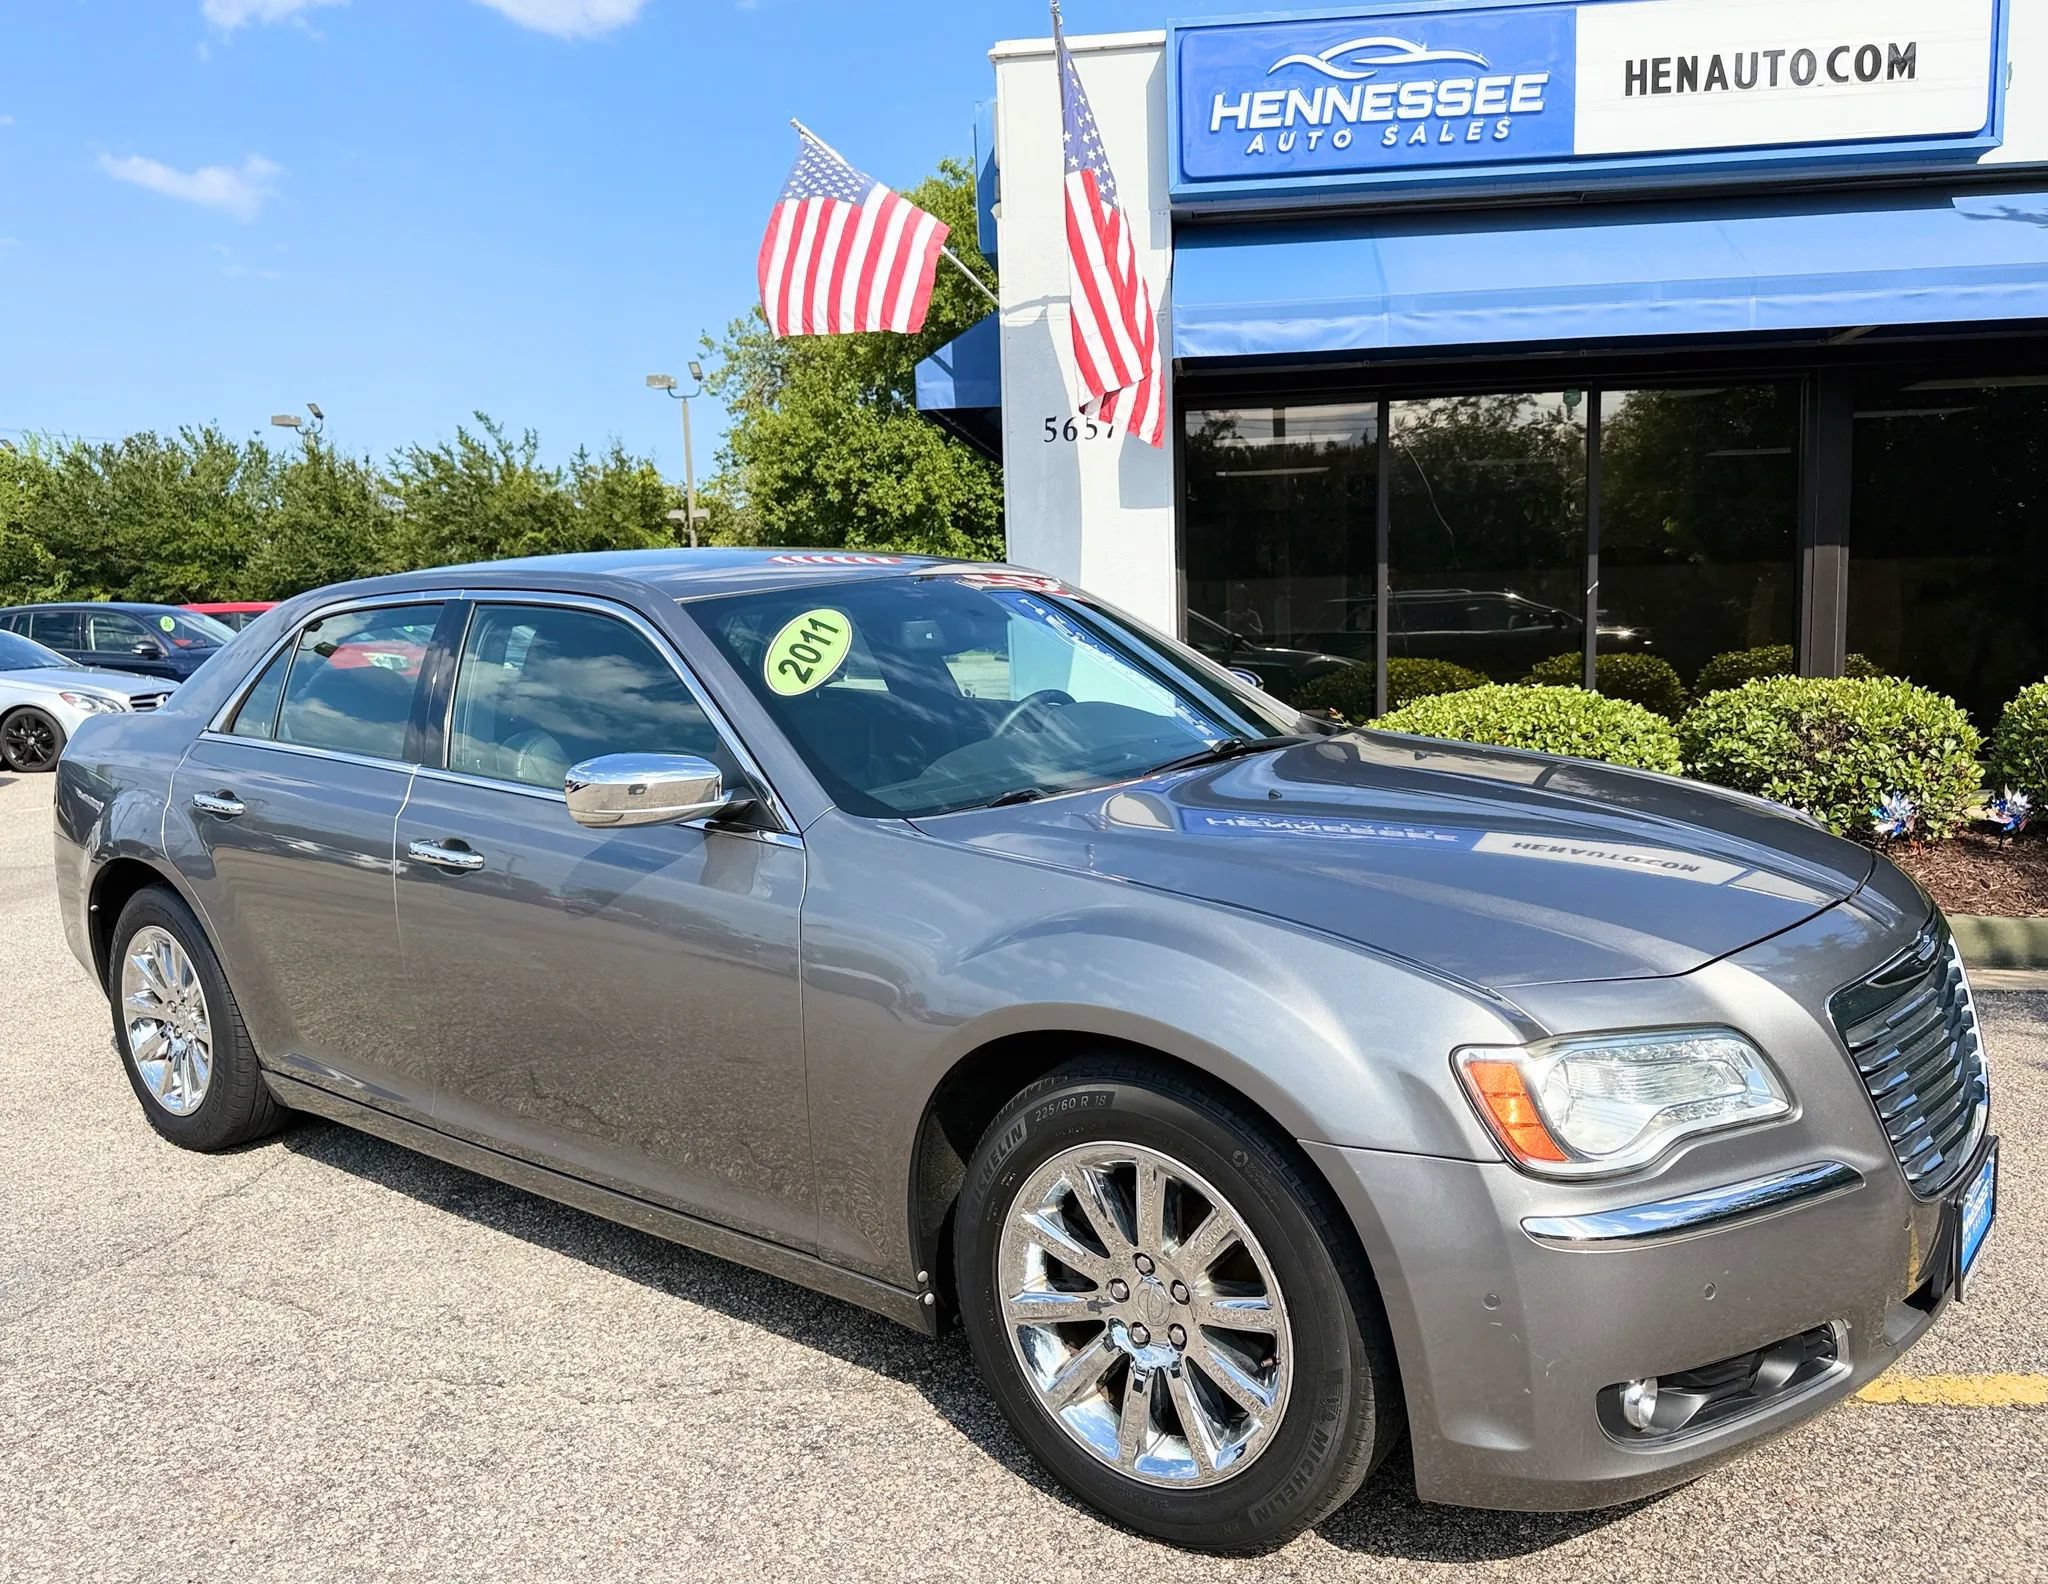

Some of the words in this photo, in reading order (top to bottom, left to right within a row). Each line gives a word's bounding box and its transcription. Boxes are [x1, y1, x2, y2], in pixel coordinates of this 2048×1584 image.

[1209, 71, 1550, 132] HENNESSEE
[1246, 127, 1353, 154] AUTO
[1382, 117, 1511, 145] SALES
[778, 617, 839, 684] 2011
[1035, 1096, 1077, 1122] 225/60
[1080, 1095, 1089, 1107] R
[1254, 1426, 1330, 1523] MICHELIN
